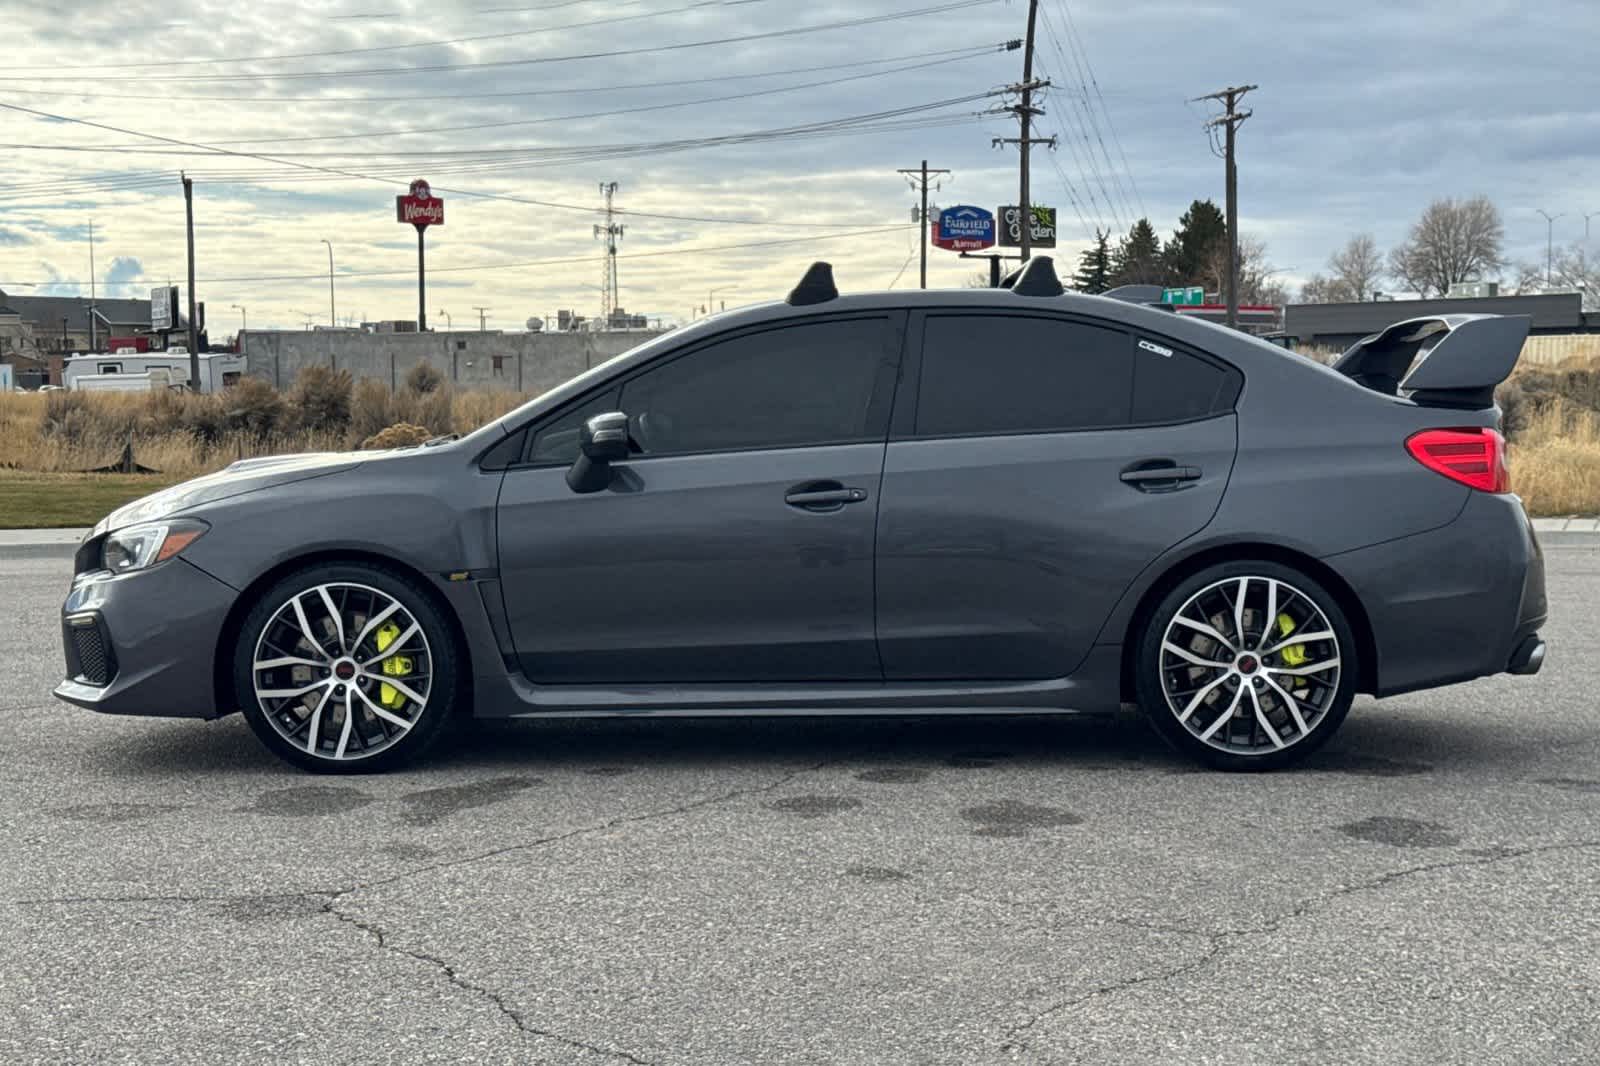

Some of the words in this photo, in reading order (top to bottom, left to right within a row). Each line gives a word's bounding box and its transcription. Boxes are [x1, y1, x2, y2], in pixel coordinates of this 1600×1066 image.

[404, 202, 443, 221] Wendy's
[1005, 209, 1037, 224] Ole
[944, 215, 990, 230] FAIRFIELD
[1009, 223, 1056, 242] Gden
[1138, 340, 1173, 357] COBB
